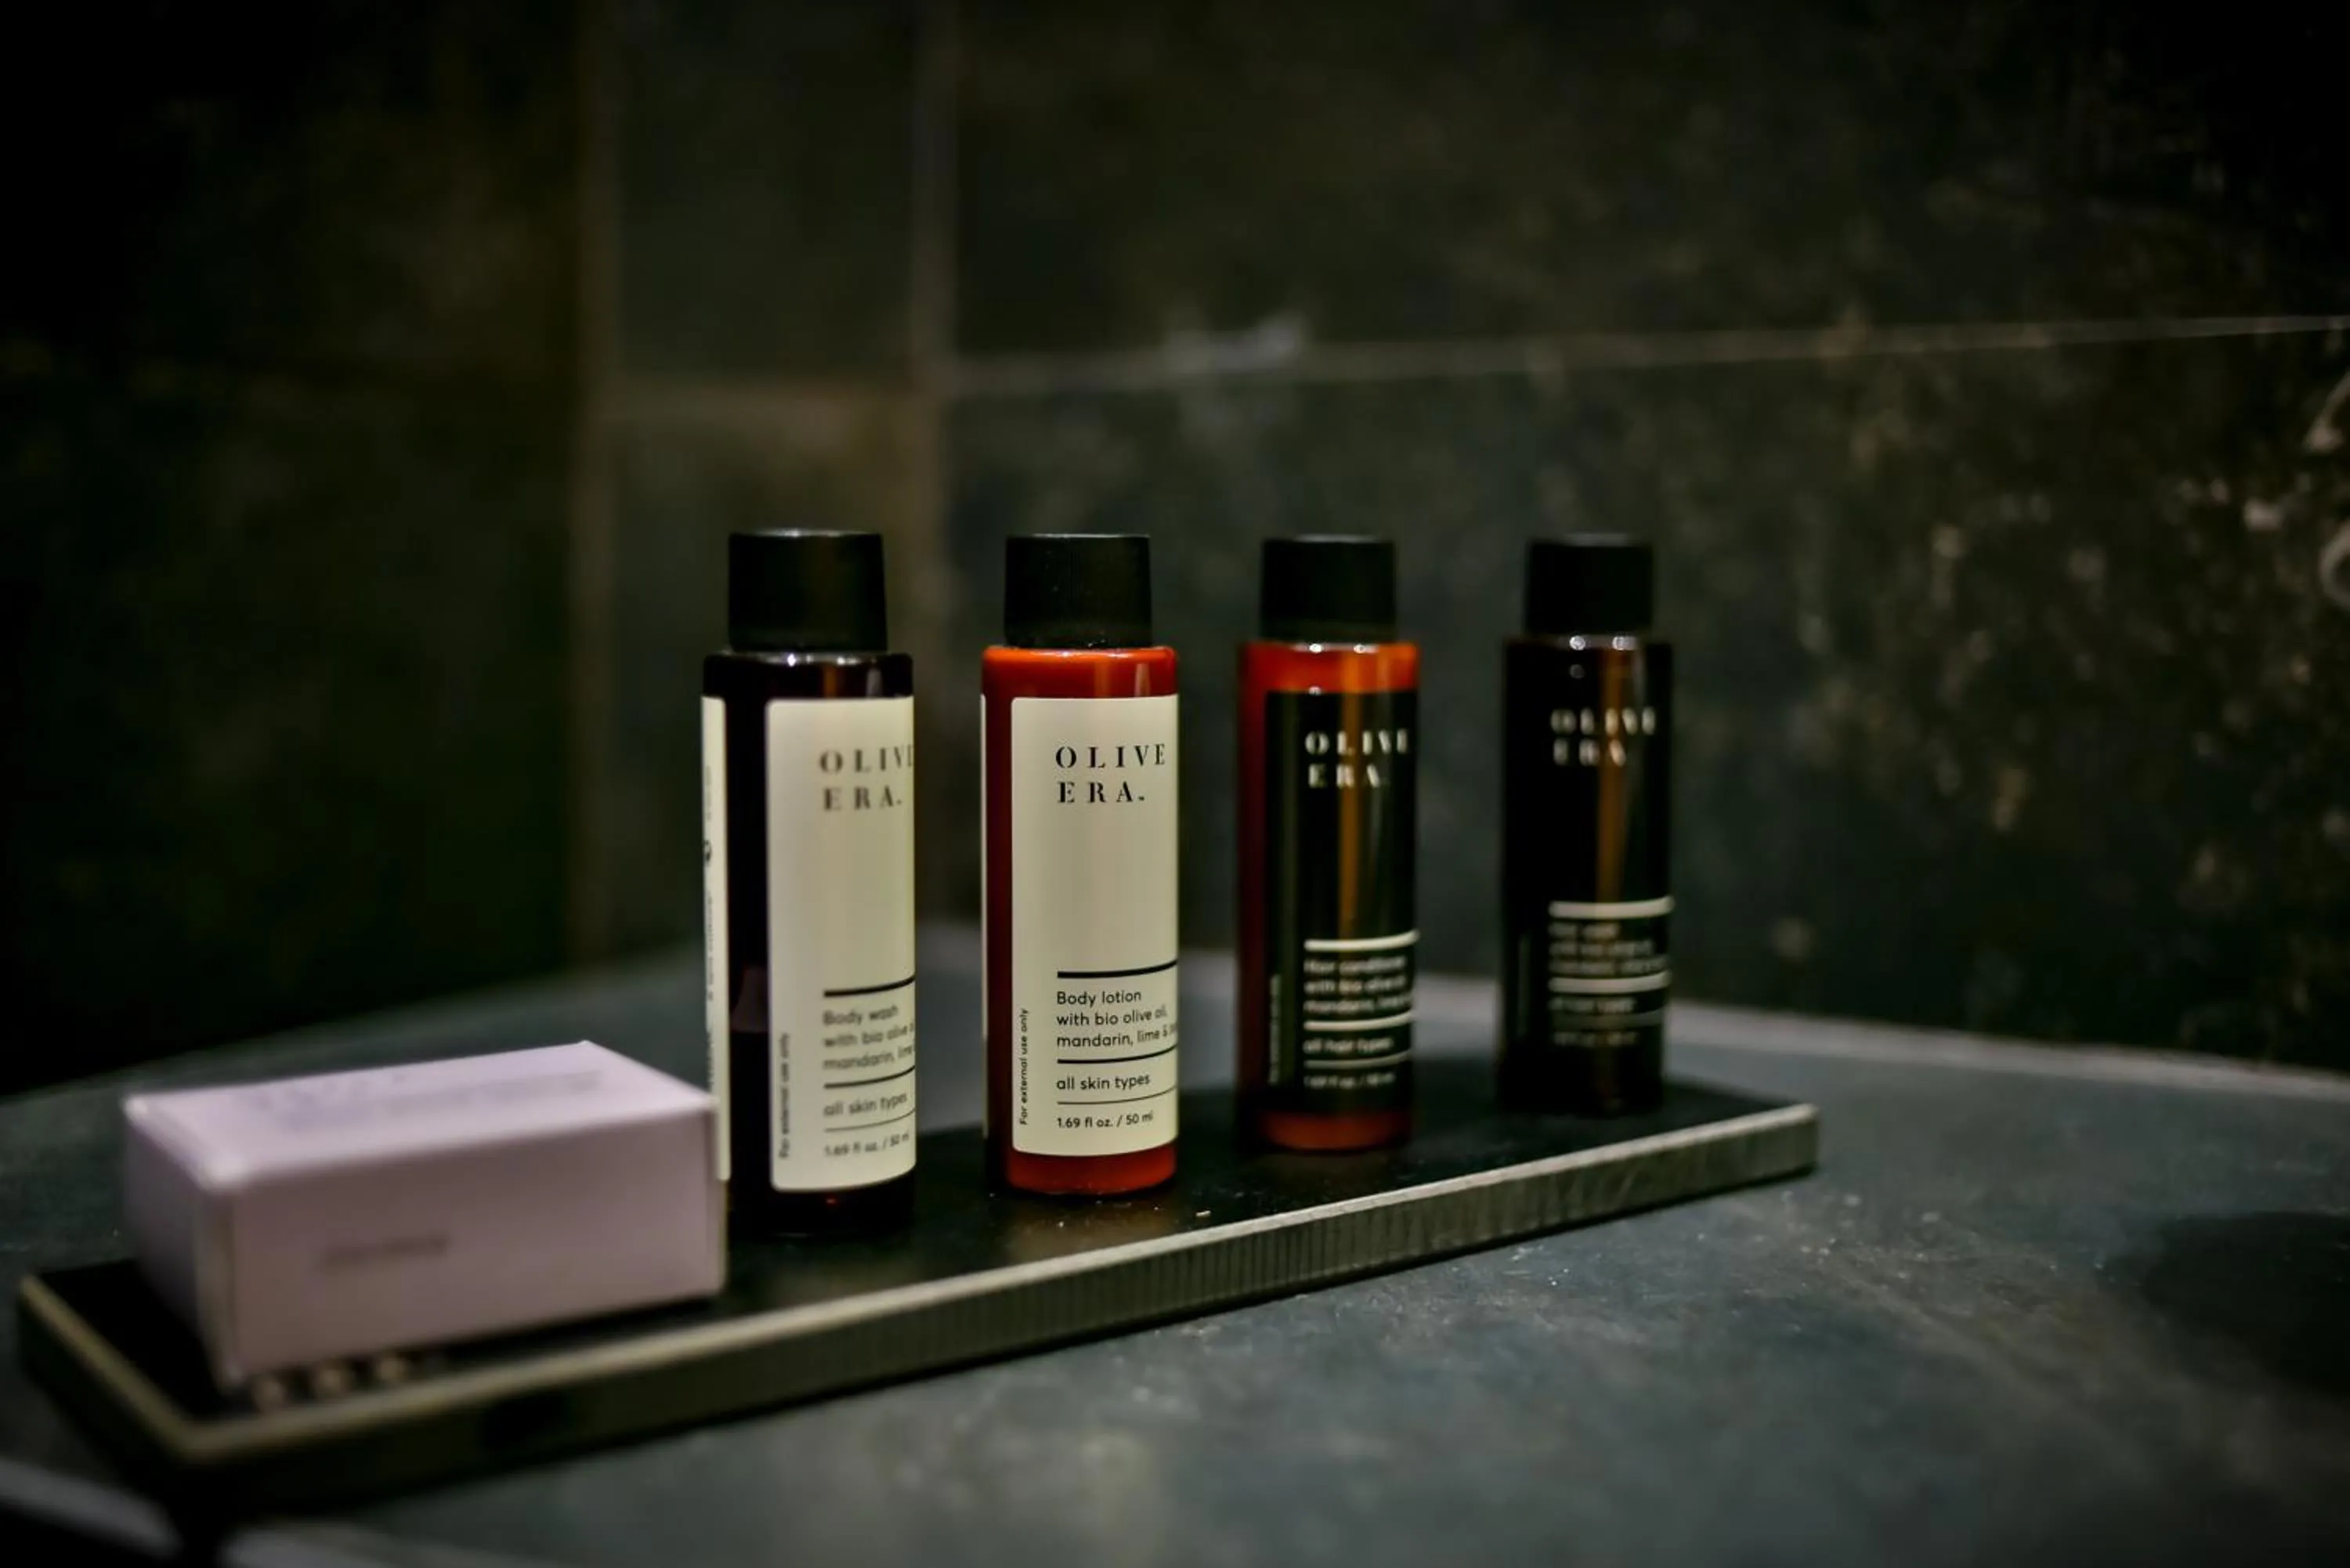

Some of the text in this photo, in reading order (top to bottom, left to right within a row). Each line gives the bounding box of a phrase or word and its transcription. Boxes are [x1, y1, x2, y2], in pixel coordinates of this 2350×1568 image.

[1055, 743, 1166, 768] OLIVE
[1058, 990, 1141, 1008] Body lotion
[822, 1010, 862, 1026] Body
[1019, 1008, 1029, 1032] only
[1058, 1012, 1090, 1026] with
[1094, 1011, 1119, 1025] bio
[1123, 1008, 1152, 1024] olive
[824, 1033, 859, 1047] with
[1058, 1033, 1133, 1047] mandarin,
[1137, 1029, 1160, 1043] lime
[1019, 1057, 1029, 1104] external
[1058, 1075, 1150, 1089] all skin types
[823, 1100, 844, 1116] all
[848, 1098, 877, 1115] skin
[1019, 1105, 1028, 1125] For
[1058, 1116, 1080, 1128] 1.69
[1126, 1113, 1140, 1125] 50
